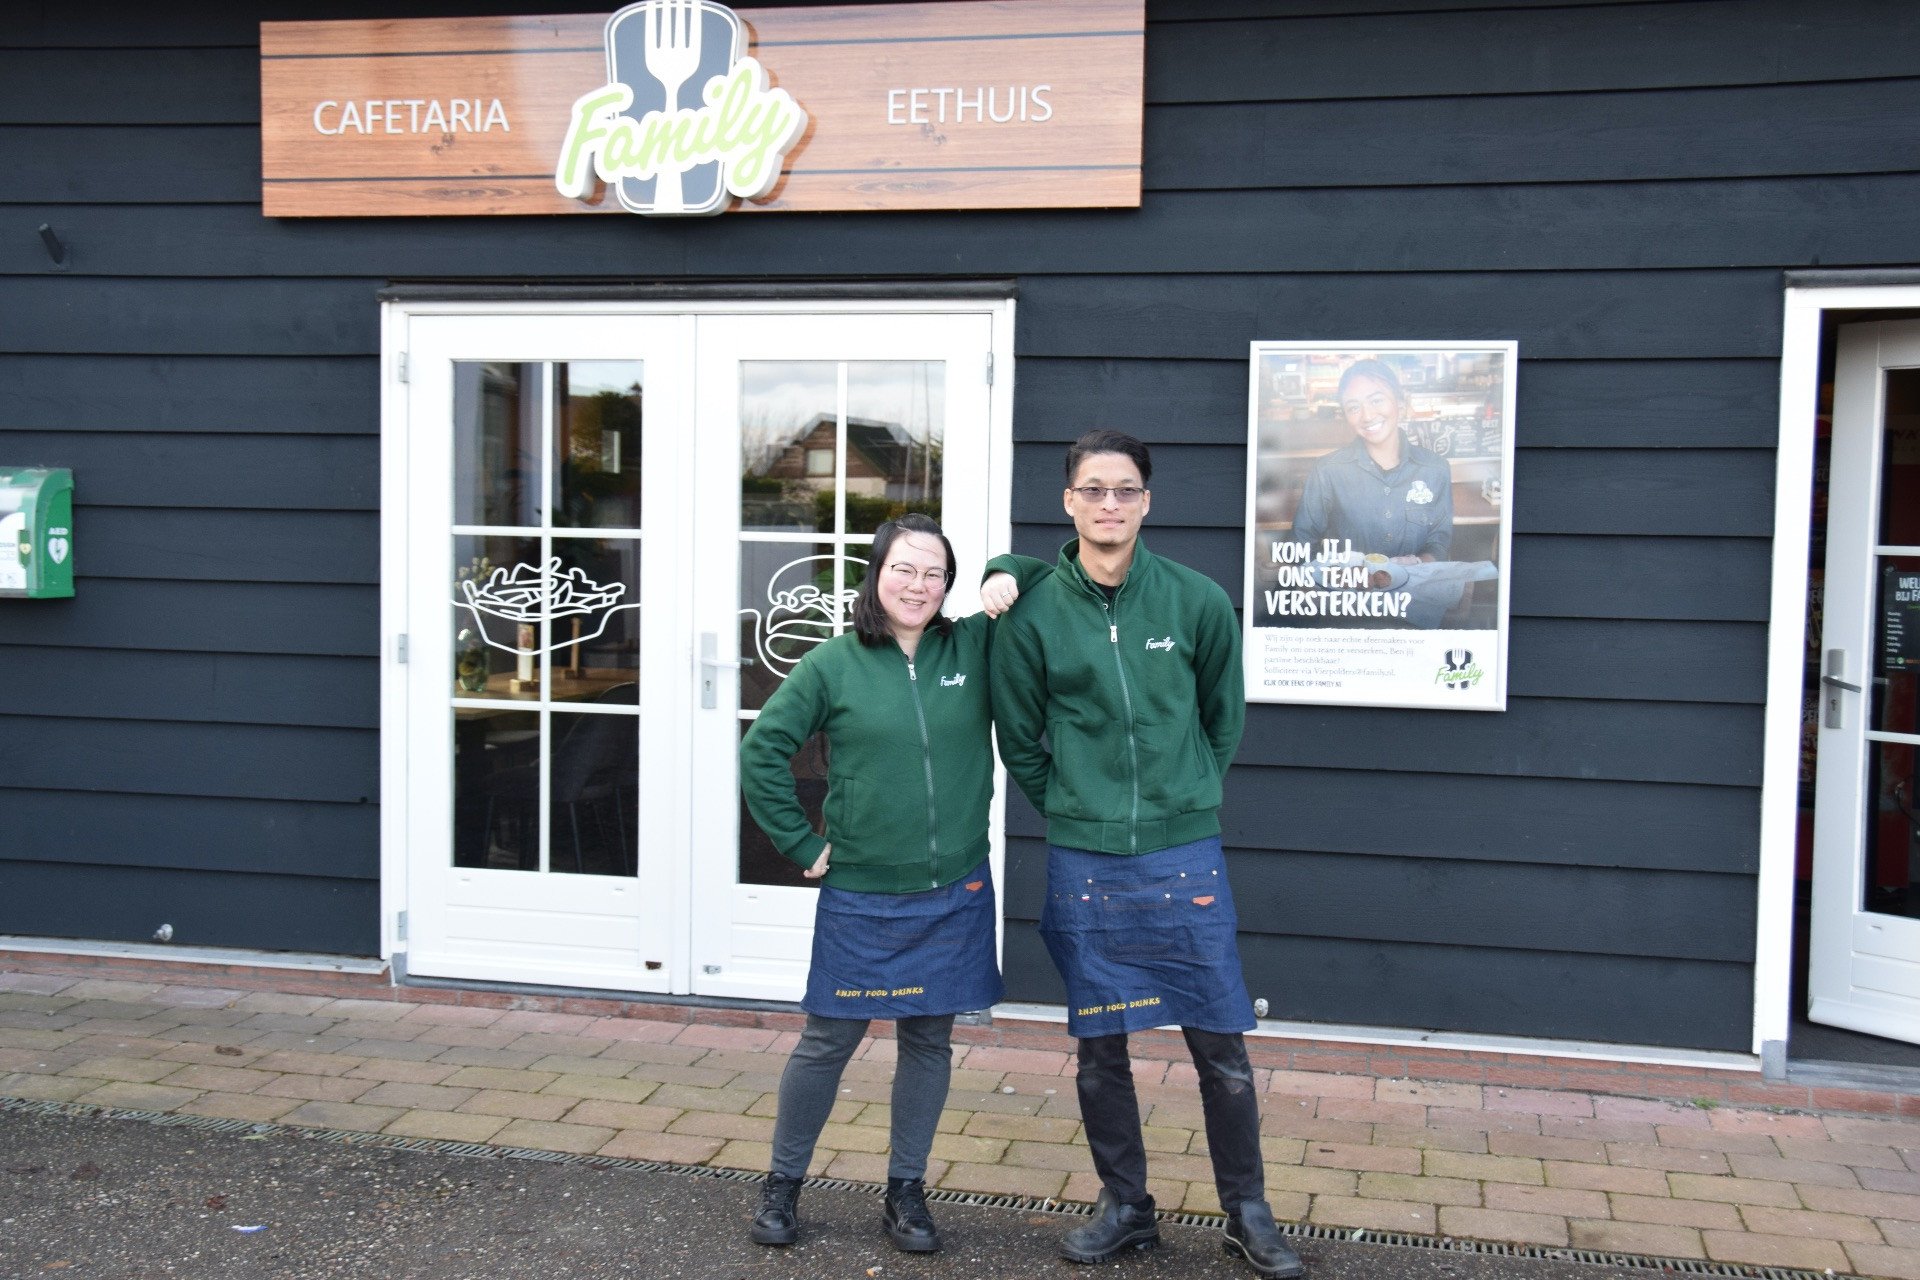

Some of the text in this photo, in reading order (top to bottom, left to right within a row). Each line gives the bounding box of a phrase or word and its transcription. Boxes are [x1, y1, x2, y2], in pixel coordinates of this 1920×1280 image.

[887, 84, 1054, 125] EETHUIS
[313, 98, 511, 135] CAFETARIA
[563, 68, 791, 188] Family
[1271, 538, 1352, 564] KOM JIJ
[1278, 566, 1369, 588] ONS TEAM
[1264, 590, 1412, 618] VERSTERKEN?
[1895, 591, 1910, 601] BIJ
[1145, 636, 1176, 652] Family
[940, 673, 967, 687] Family
[1434, 663, 1485, 686] Family
[835, 986, 924, 998] ENJOY FOOD DRINKS
[1078, 997, 1161, 1016] ENJOY FOOD DRINKS
